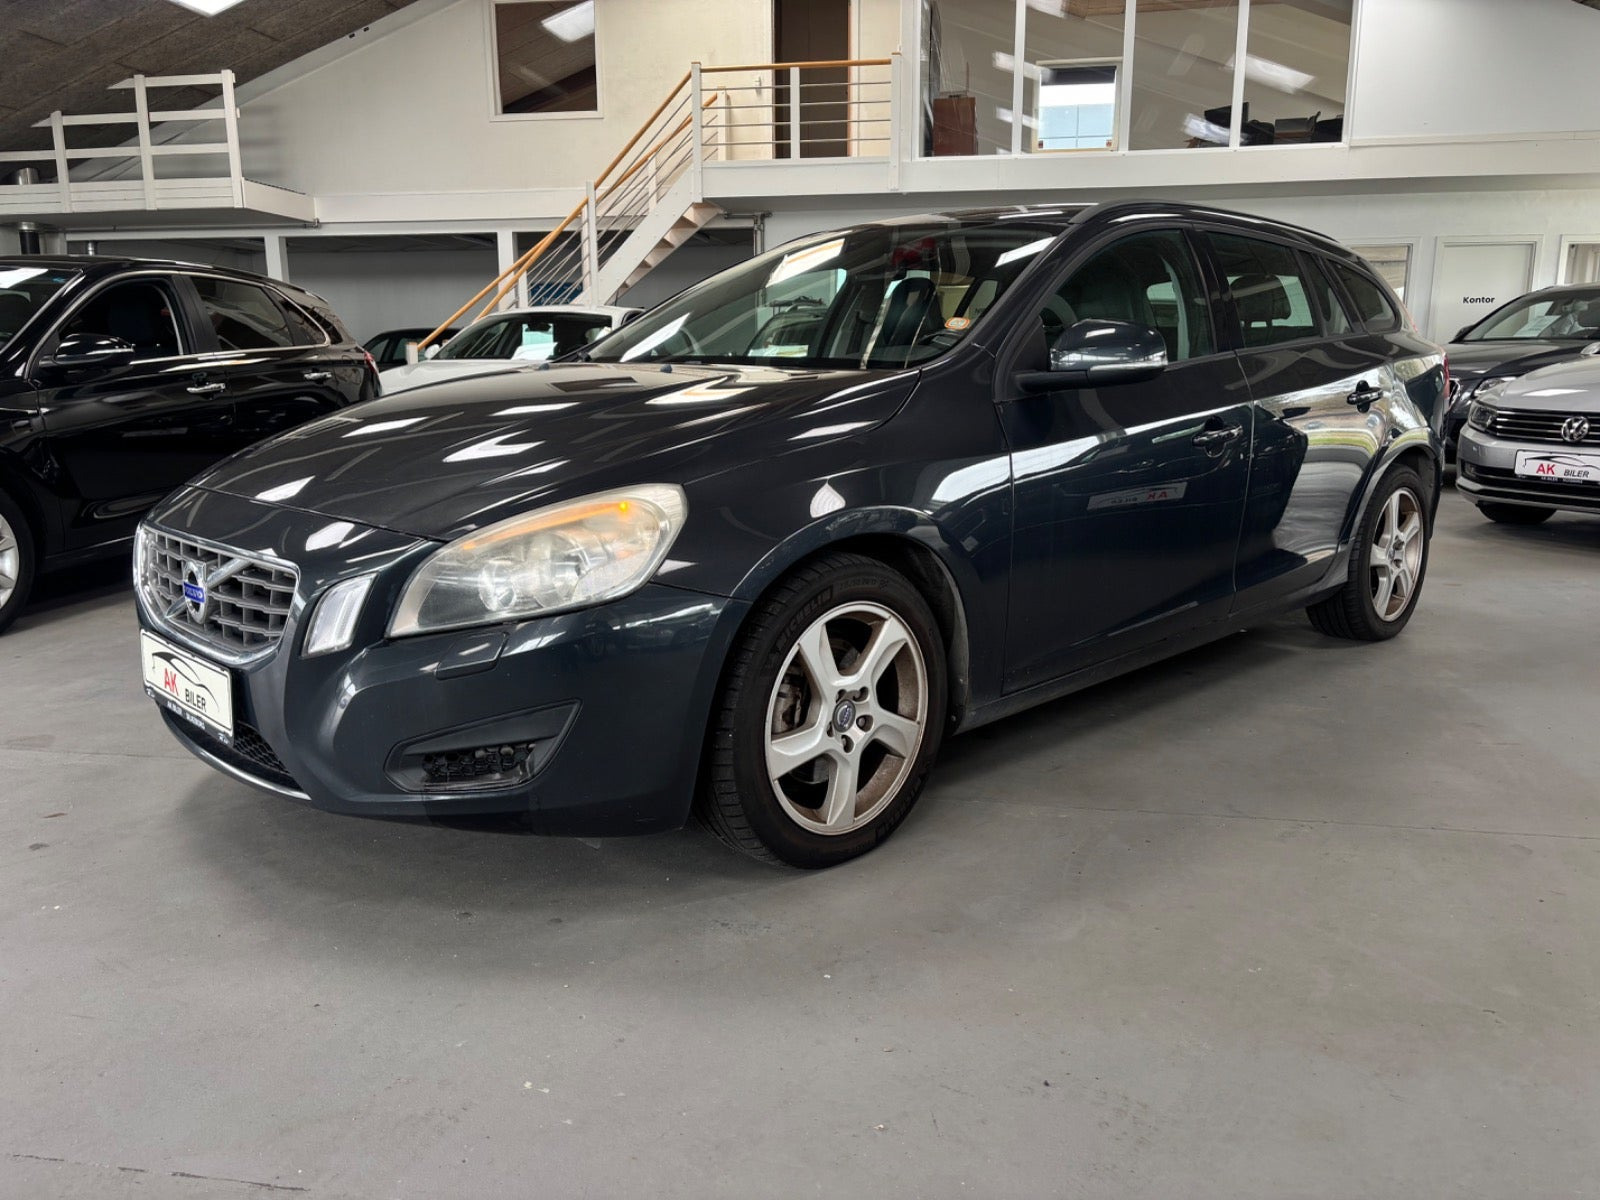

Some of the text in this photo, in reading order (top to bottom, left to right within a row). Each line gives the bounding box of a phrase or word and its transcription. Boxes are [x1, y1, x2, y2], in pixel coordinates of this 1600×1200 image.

[1462, 296, 1495, 304] Kontor
[1535, 463, 1590, 478] AK BILER
[164, 667, 207, 713] AK BILER
